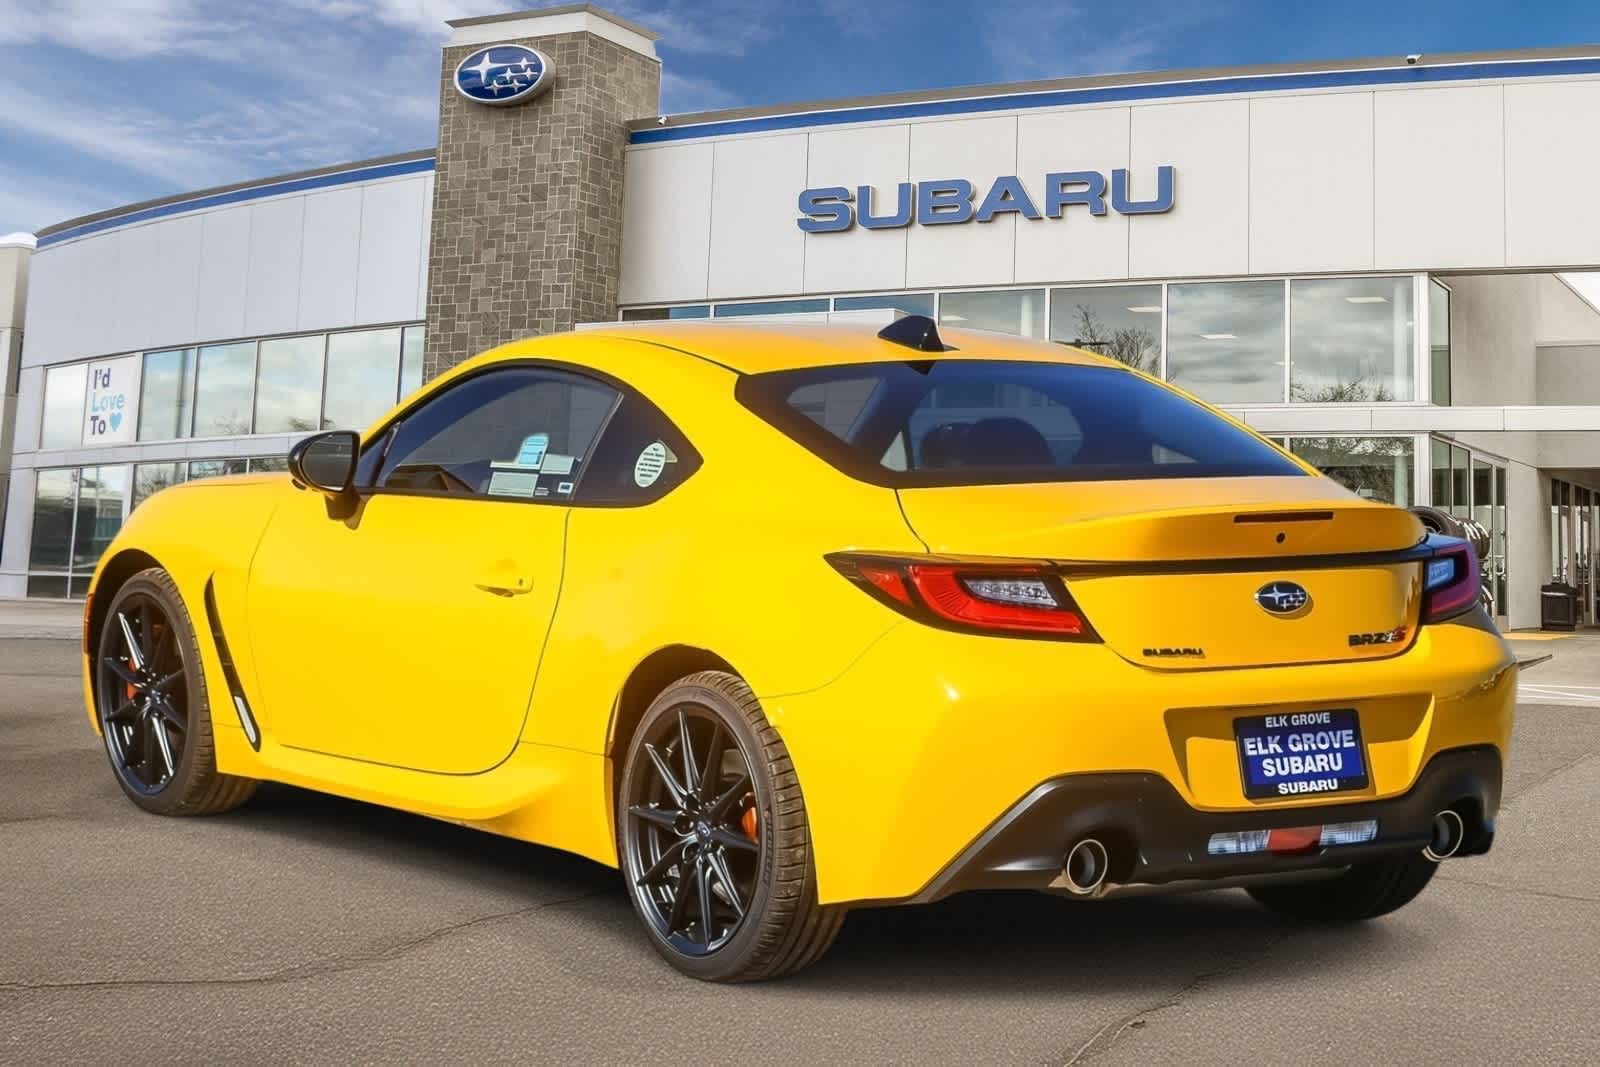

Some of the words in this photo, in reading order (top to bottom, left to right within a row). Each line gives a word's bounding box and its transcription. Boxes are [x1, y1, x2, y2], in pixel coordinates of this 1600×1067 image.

[797, 166, 1176, 233] SUBARU
[93, 368, 111, 389] I'd
[91, 392, 125, 412] Love
[90, 415, 106, 435] To
[1142, 648, 1204, 657] SUBARU
[1265, 716, 1288, 728] ELK
[1291, 712, 1331, 726] GROVE
[1243, 735, 1283, 756] ELK
[1287, 729, 1356, 752] GROVE
[1262, 752, 1343, 777] SUBARU
[1278, 778, 1338, 795] SUBARU
